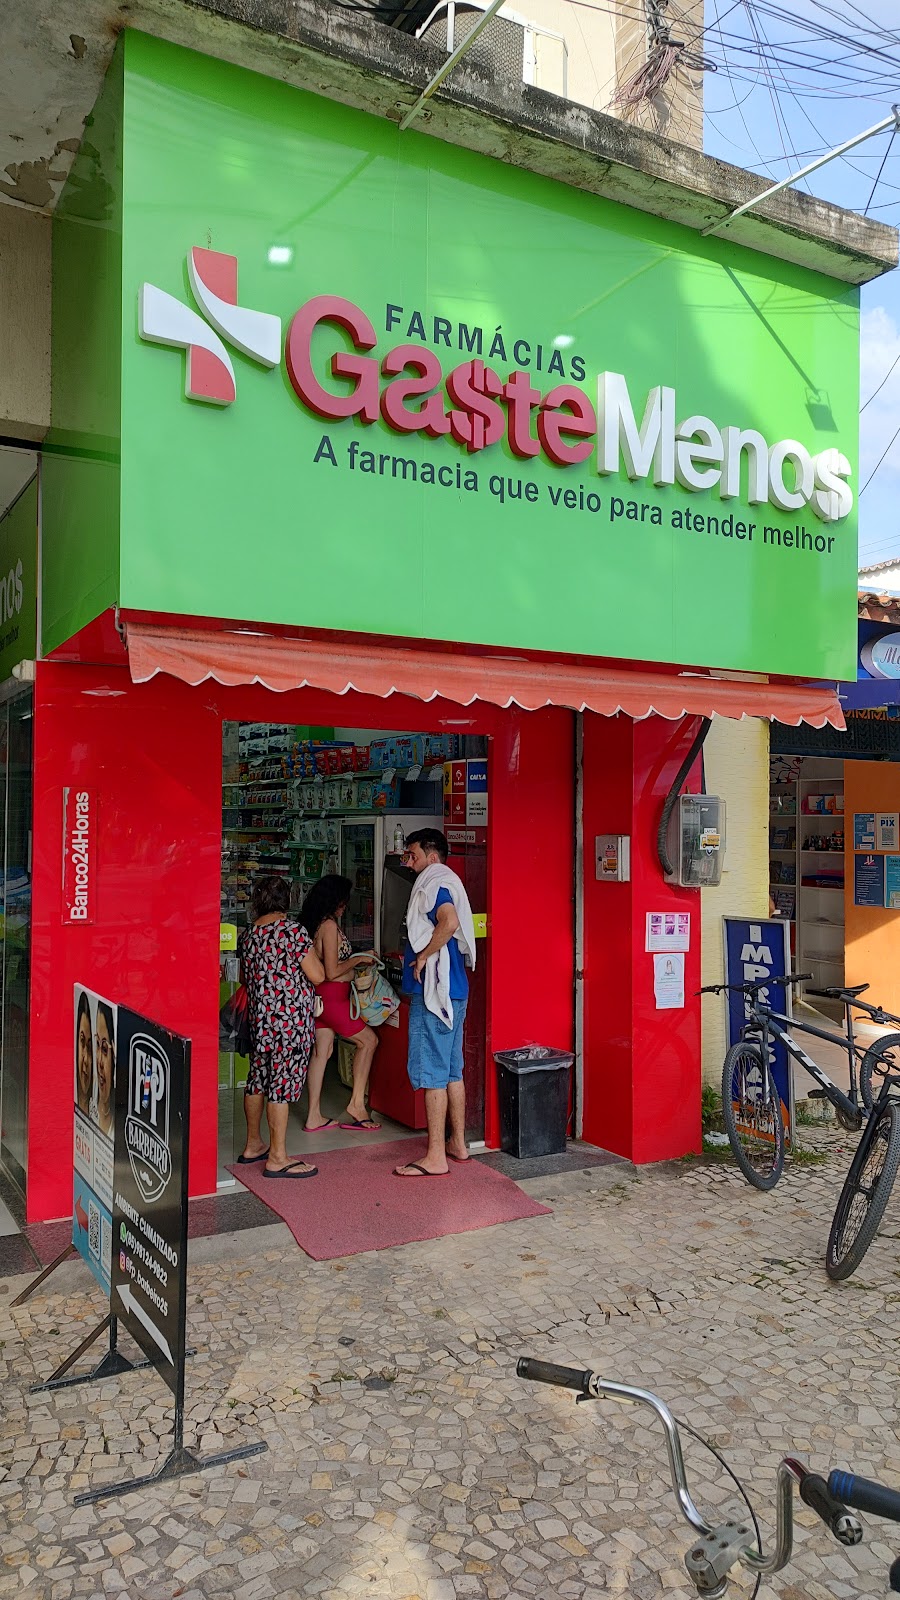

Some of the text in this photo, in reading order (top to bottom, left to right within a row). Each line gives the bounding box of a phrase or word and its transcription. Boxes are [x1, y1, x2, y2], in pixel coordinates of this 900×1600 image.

[385, 303, 586, 382] FARMÁCIAS
[313, 435, 835, 553] A farmacia que veio para atender melhor
[70, 791, 89, 920] Banco24Horas
[880, 819, 895, 827] PIX
[128, 1121, 168, 1175] BARBEIRO
[114, 1192, 178, 1268] AMBIENTE CLIMATIZADO
